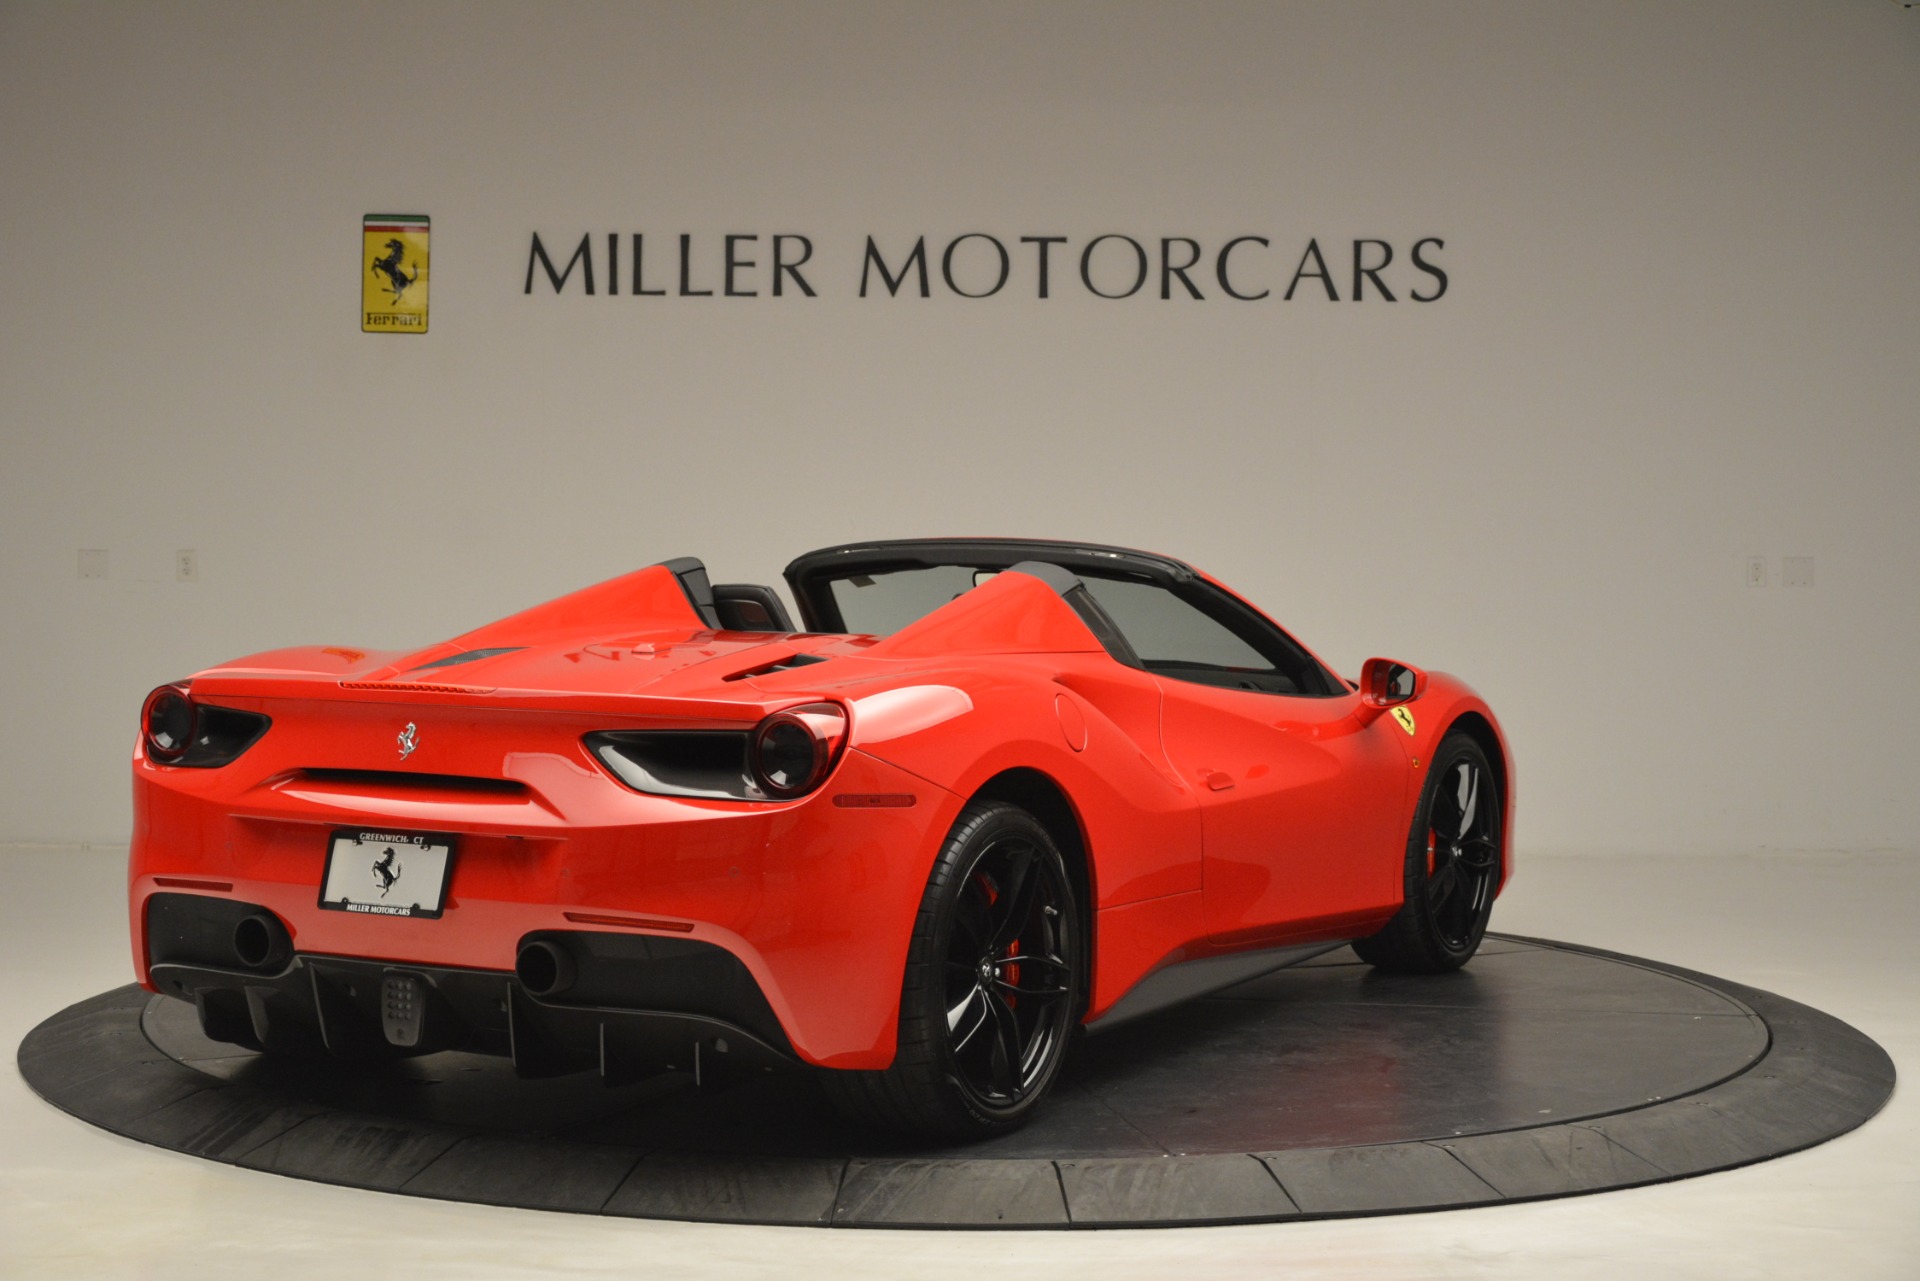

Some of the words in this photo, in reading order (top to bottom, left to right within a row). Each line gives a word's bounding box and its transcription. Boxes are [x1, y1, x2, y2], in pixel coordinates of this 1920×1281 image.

[524, 232, 817, 297] MILLER
[859, 234, 1448, 303] MOTORCARS
[365, 312, 422, 326] Ferrari
[413, 836, 424, 844] CT
[346, 904, 370, 913] MILLER
[370, 906, 411, 916] MOTORCARS
